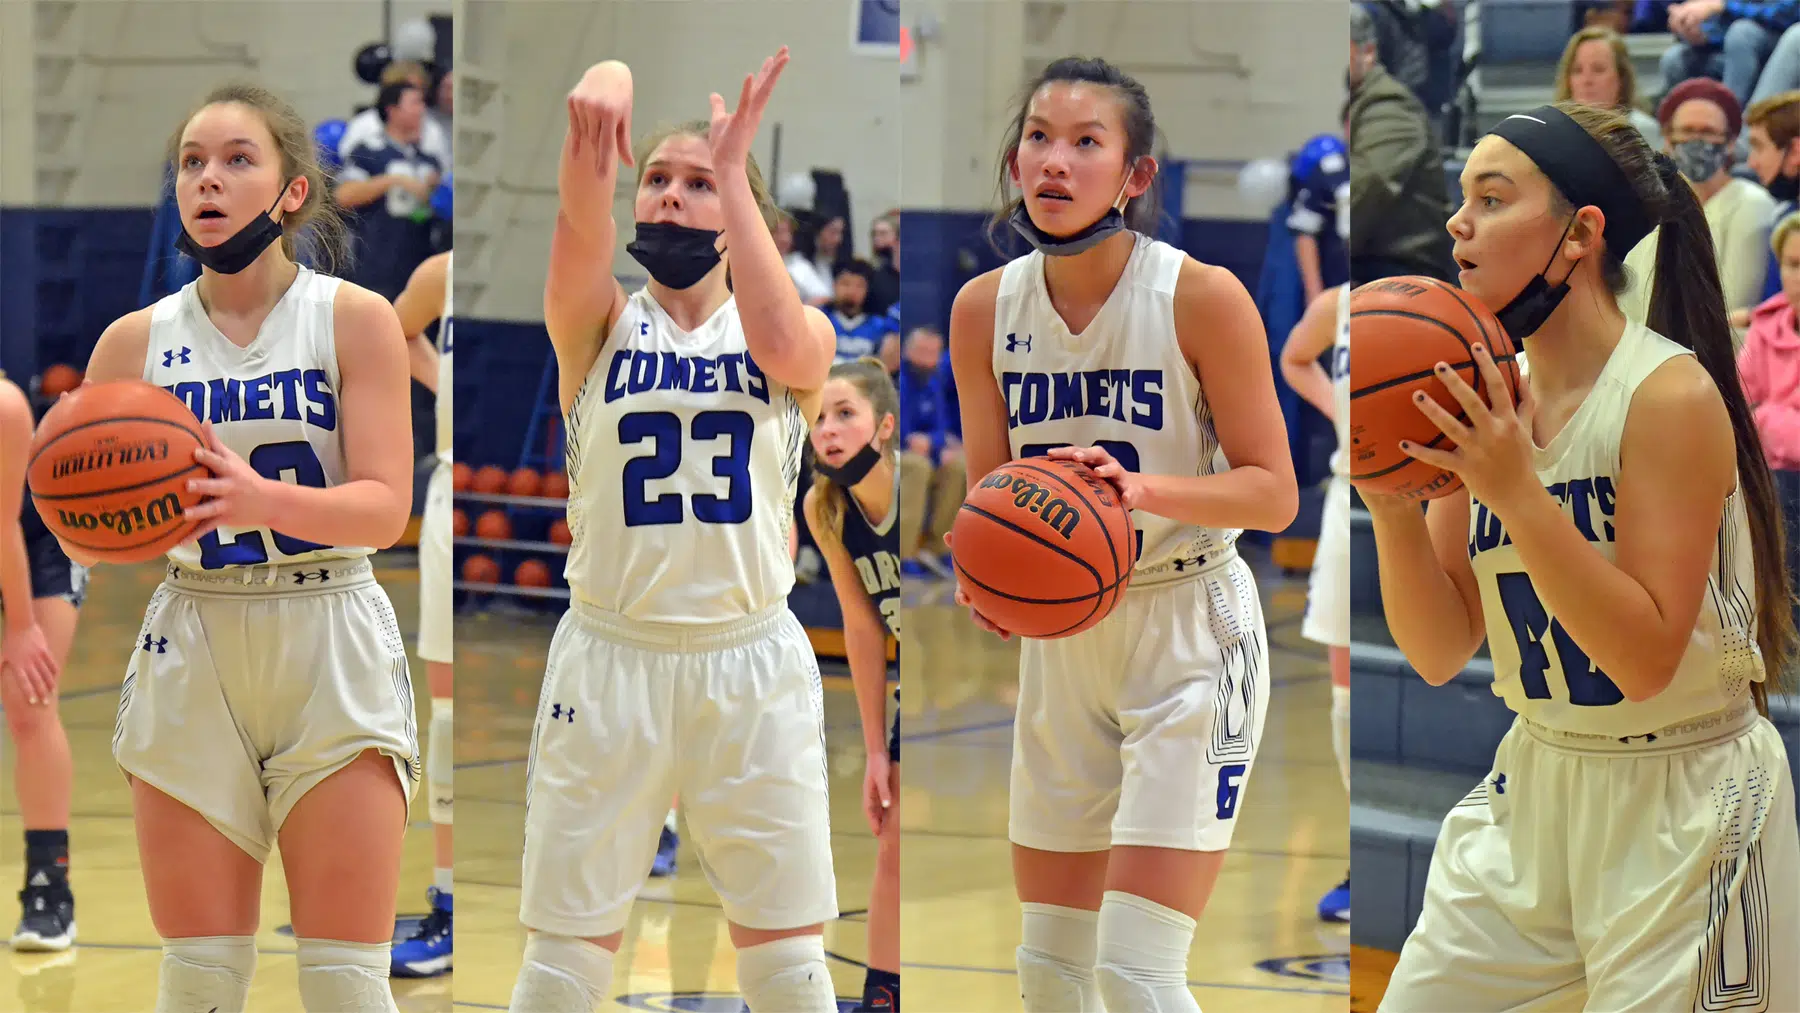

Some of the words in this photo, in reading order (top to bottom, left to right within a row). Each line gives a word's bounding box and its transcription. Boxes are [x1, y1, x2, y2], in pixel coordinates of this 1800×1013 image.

[161, 368, 336, 432] OMETS
[604, 349, 771, 405] COMETS
[1002, 369, 1163, 431] COMETS
[618, 411, 755, 527] 23
[57, 492, 183, 536] Wilson
[198, 440, 335, 570] 0
[981, 473, 1080, 540] Wilson
